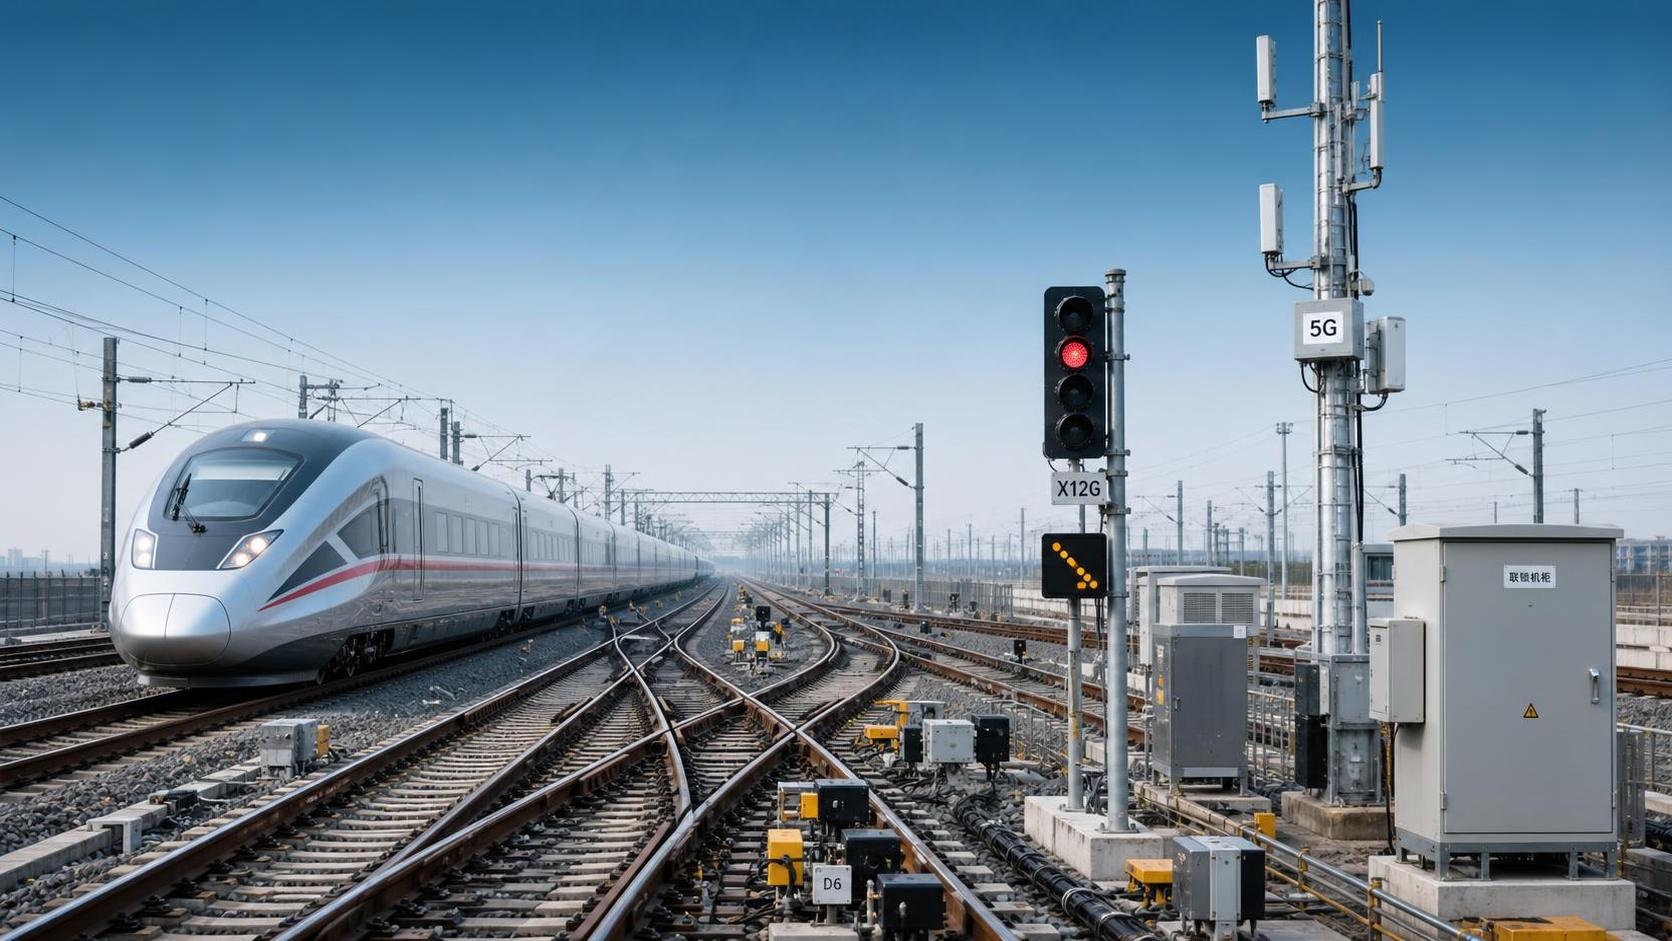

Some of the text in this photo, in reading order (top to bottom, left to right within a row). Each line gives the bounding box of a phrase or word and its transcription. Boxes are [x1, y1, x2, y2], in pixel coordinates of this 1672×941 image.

[1310, 318, 1337, 338] 5G
[1057, 480, 1101, 497] X12G
[823, 877, 842, 892] D6
